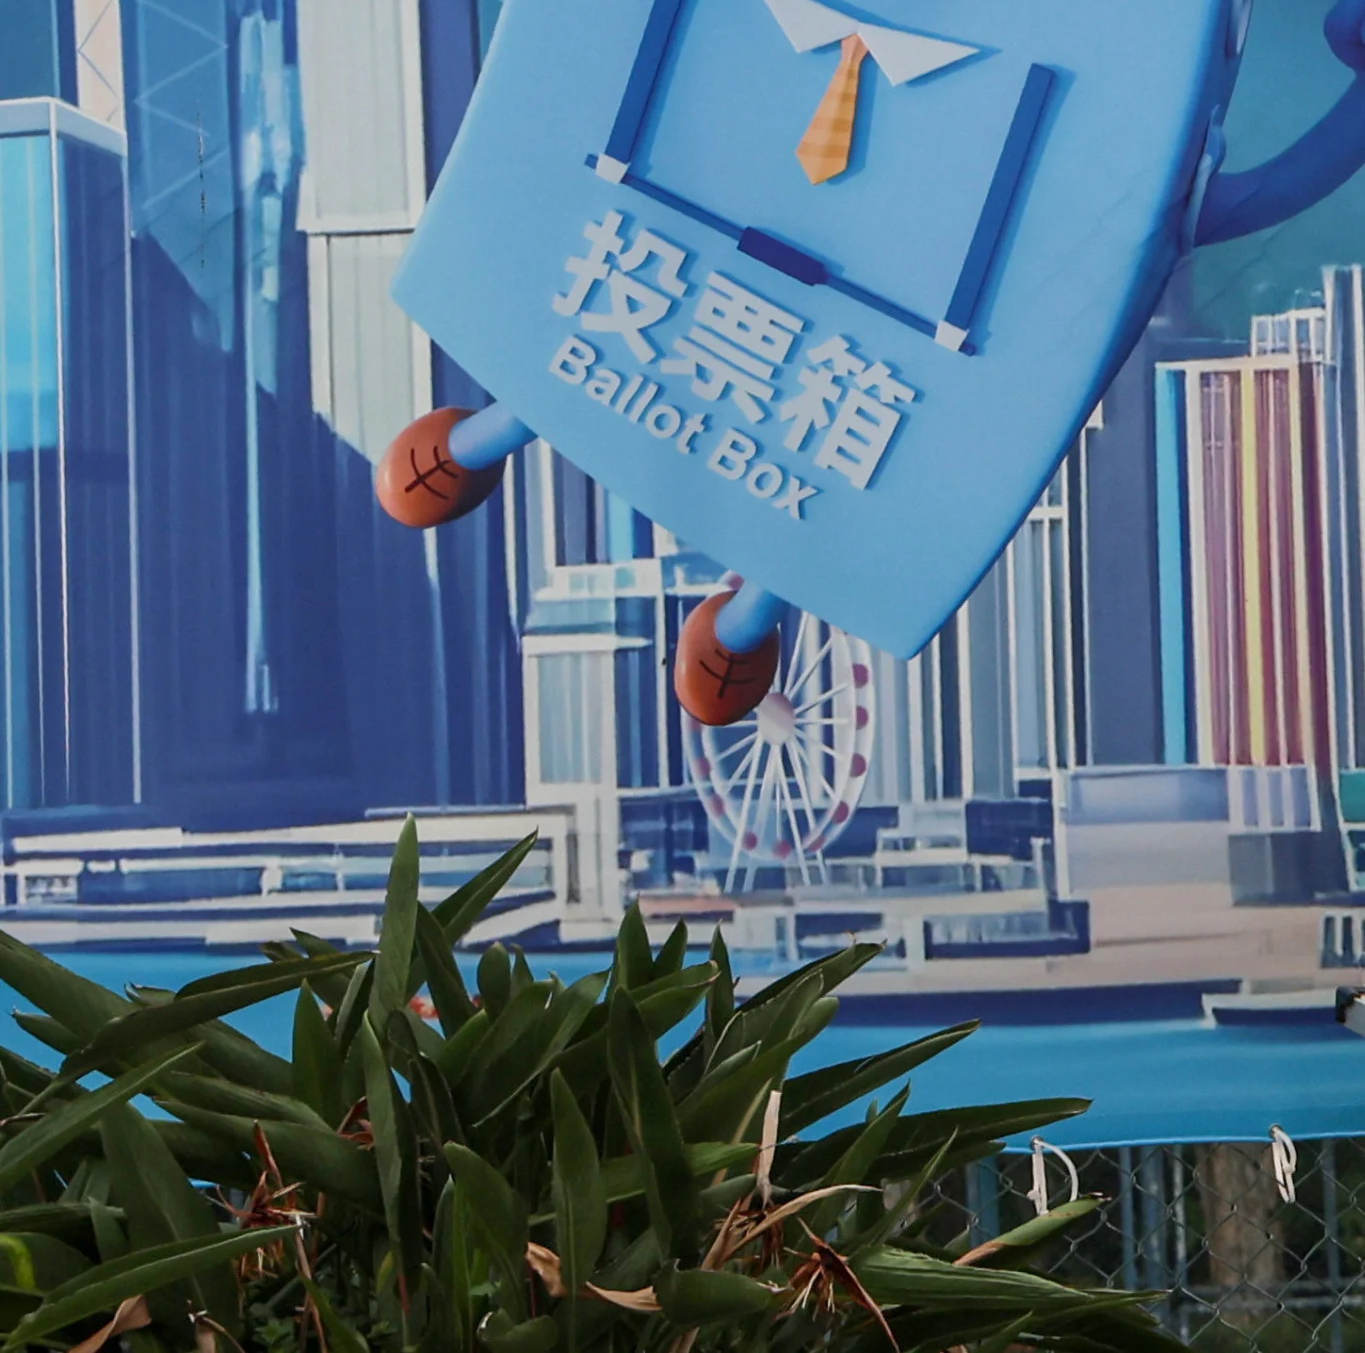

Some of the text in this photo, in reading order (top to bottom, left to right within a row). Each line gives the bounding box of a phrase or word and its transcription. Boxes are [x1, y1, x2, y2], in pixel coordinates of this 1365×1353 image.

[548, 335, 818, 520] Ballot Box
[551, 209, 917, 490] 投票箱
